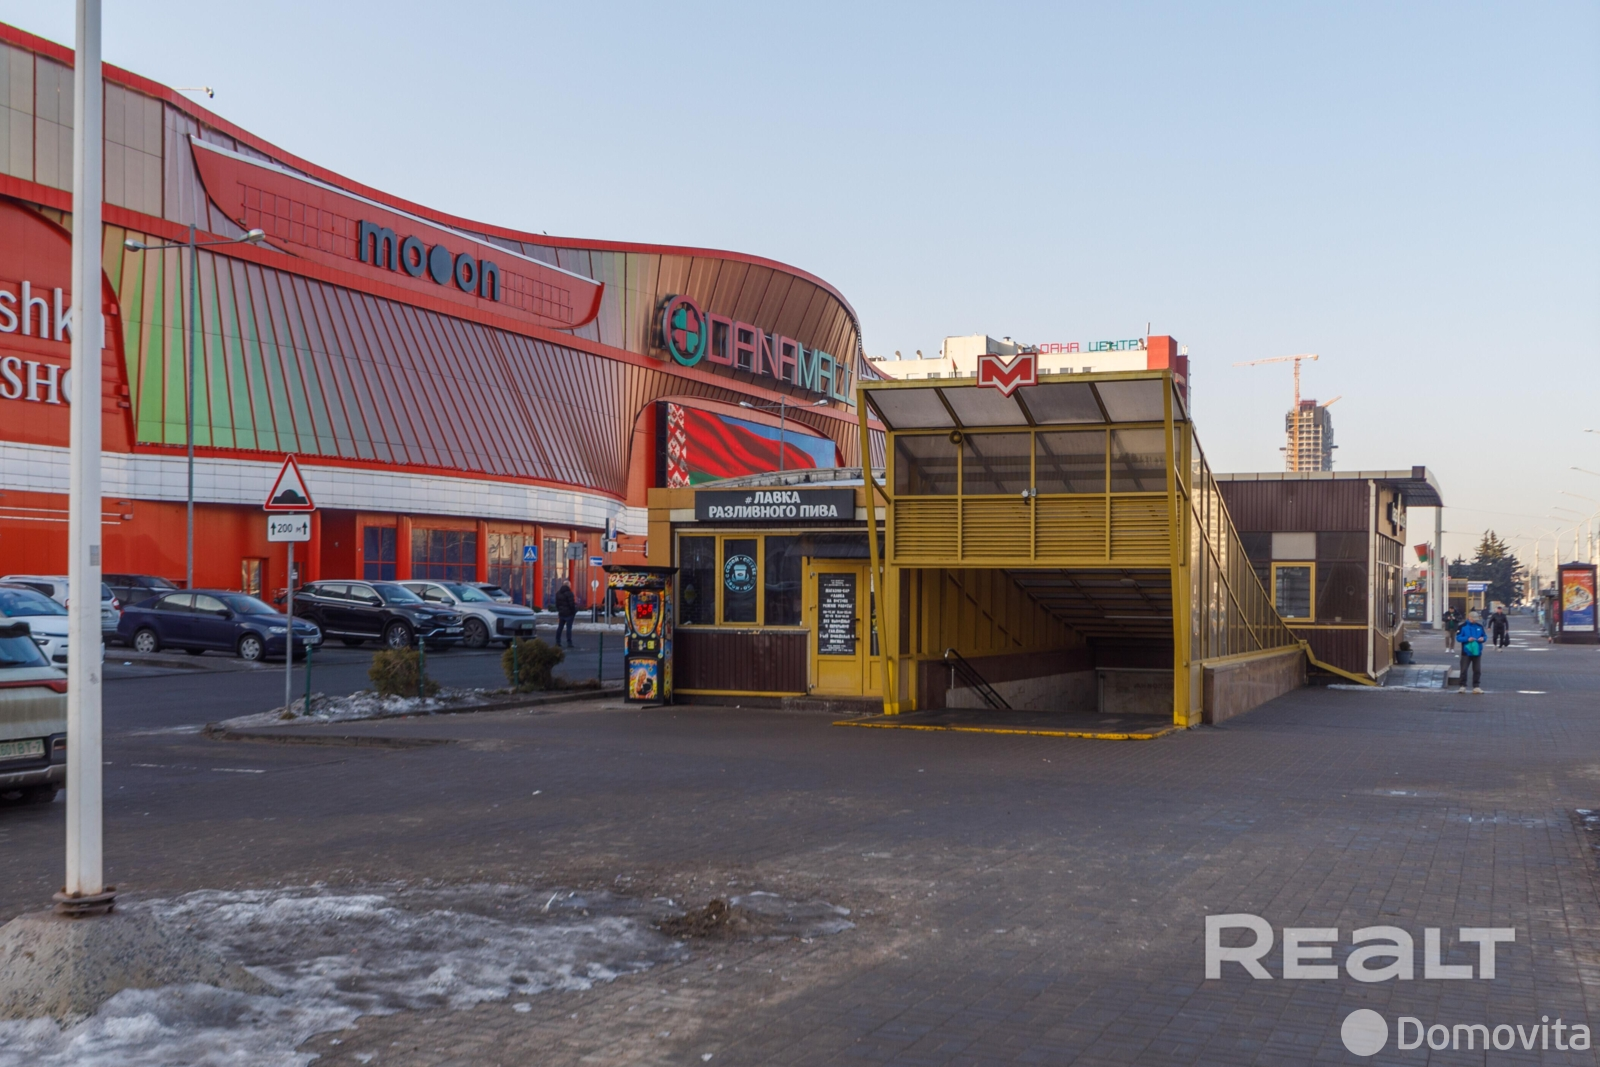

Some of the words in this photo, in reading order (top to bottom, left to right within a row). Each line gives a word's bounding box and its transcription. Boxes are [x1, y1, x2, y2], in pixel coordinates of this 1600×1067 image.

[1040, 343, 1079, 354] ДАНА
[1088, 340, 1138, 351] ЦЕНТР
[708, 505, 797, 518] РАЗЛИВНОГО
[800, 504, 838, 517] ПИВА
[277, 523, 293, 533] 200
